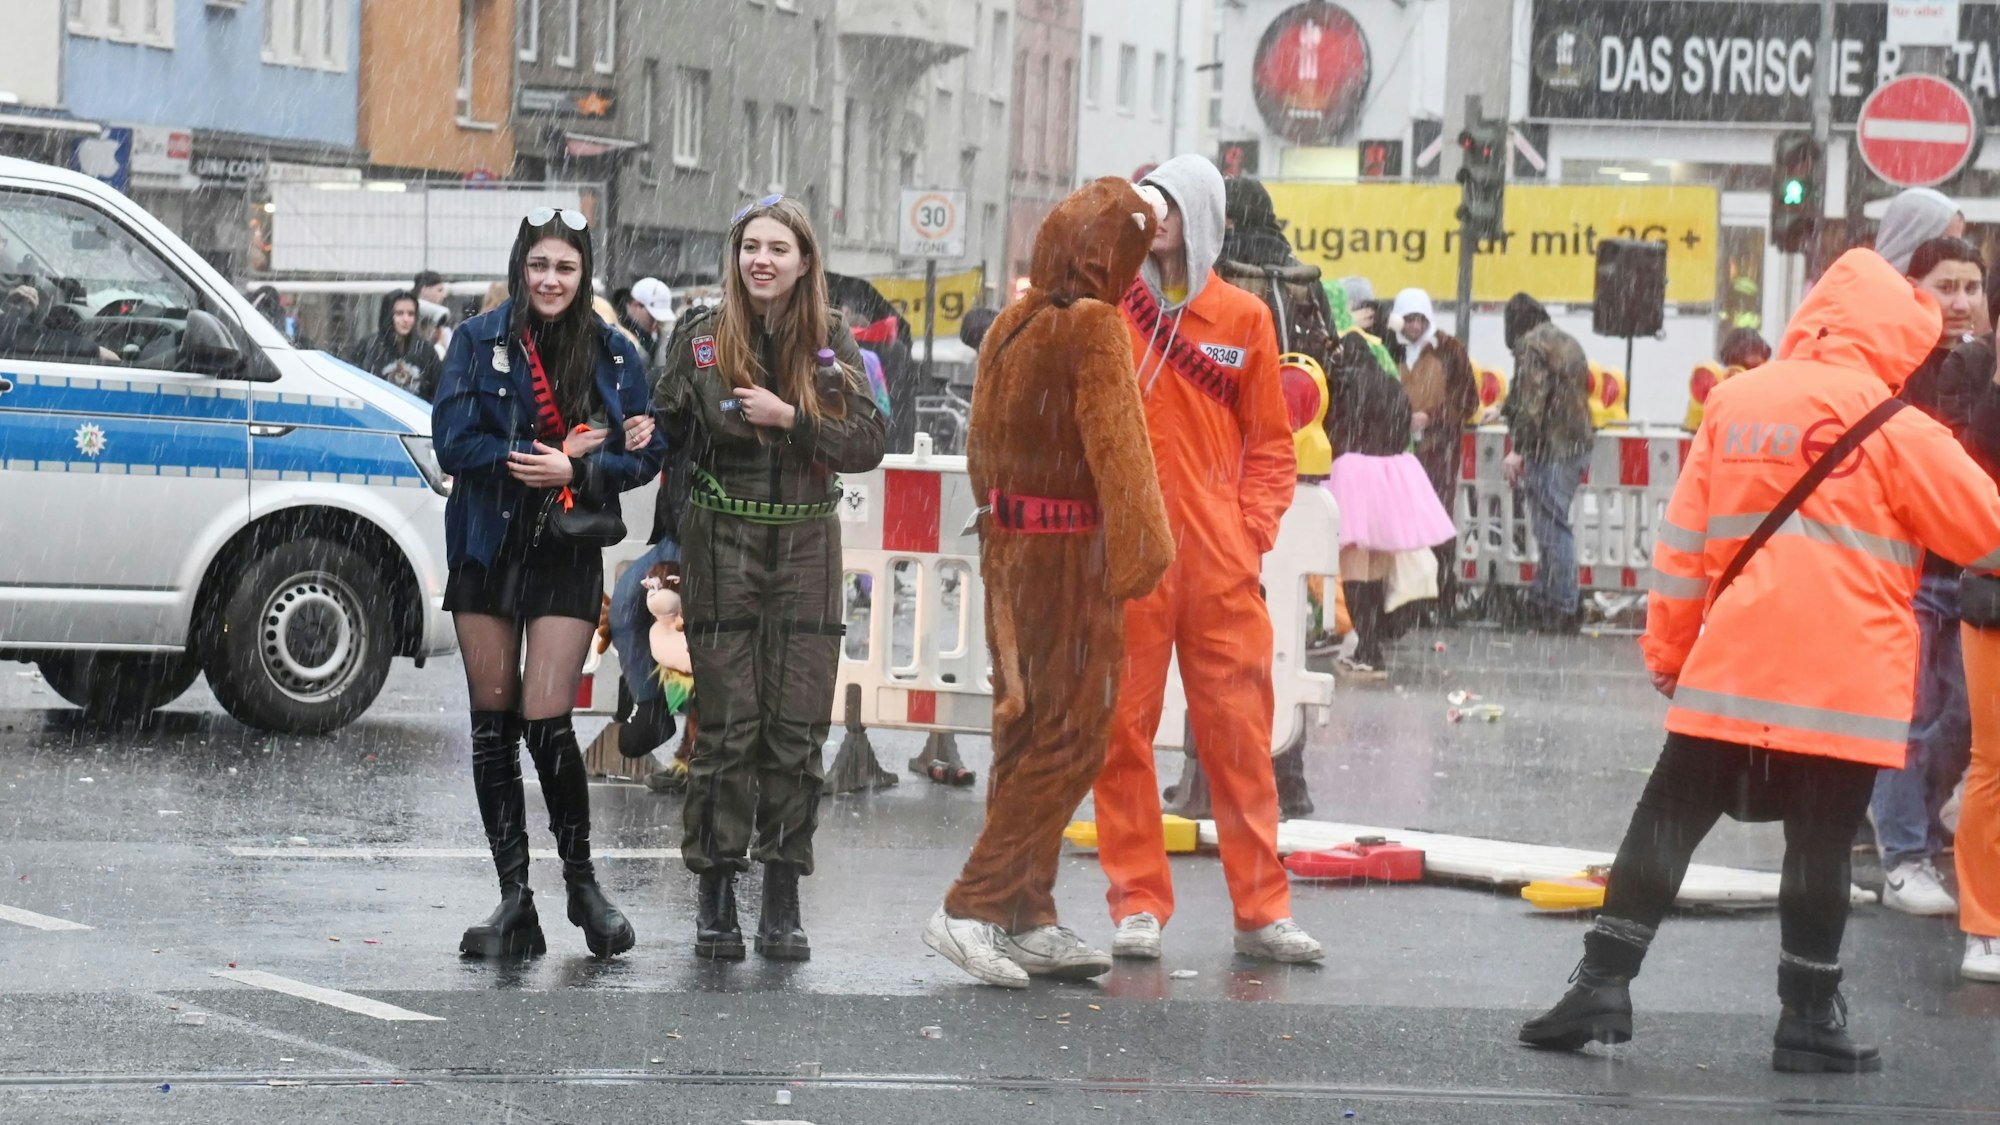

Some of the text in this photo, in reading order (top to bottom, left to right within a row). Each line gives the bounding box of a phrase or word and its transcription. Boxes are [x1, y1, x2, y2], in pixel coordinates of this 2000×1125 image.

[1600, 35, 1672, 94] DAS
[920, 205, 946, 228] 30
[914, 241, 948, 255] ZONE
[1531, 222, 1598, 256] mit
[1205, 346, 1239, 366] 28349
[1724, 422, 1800, 458] KVB
